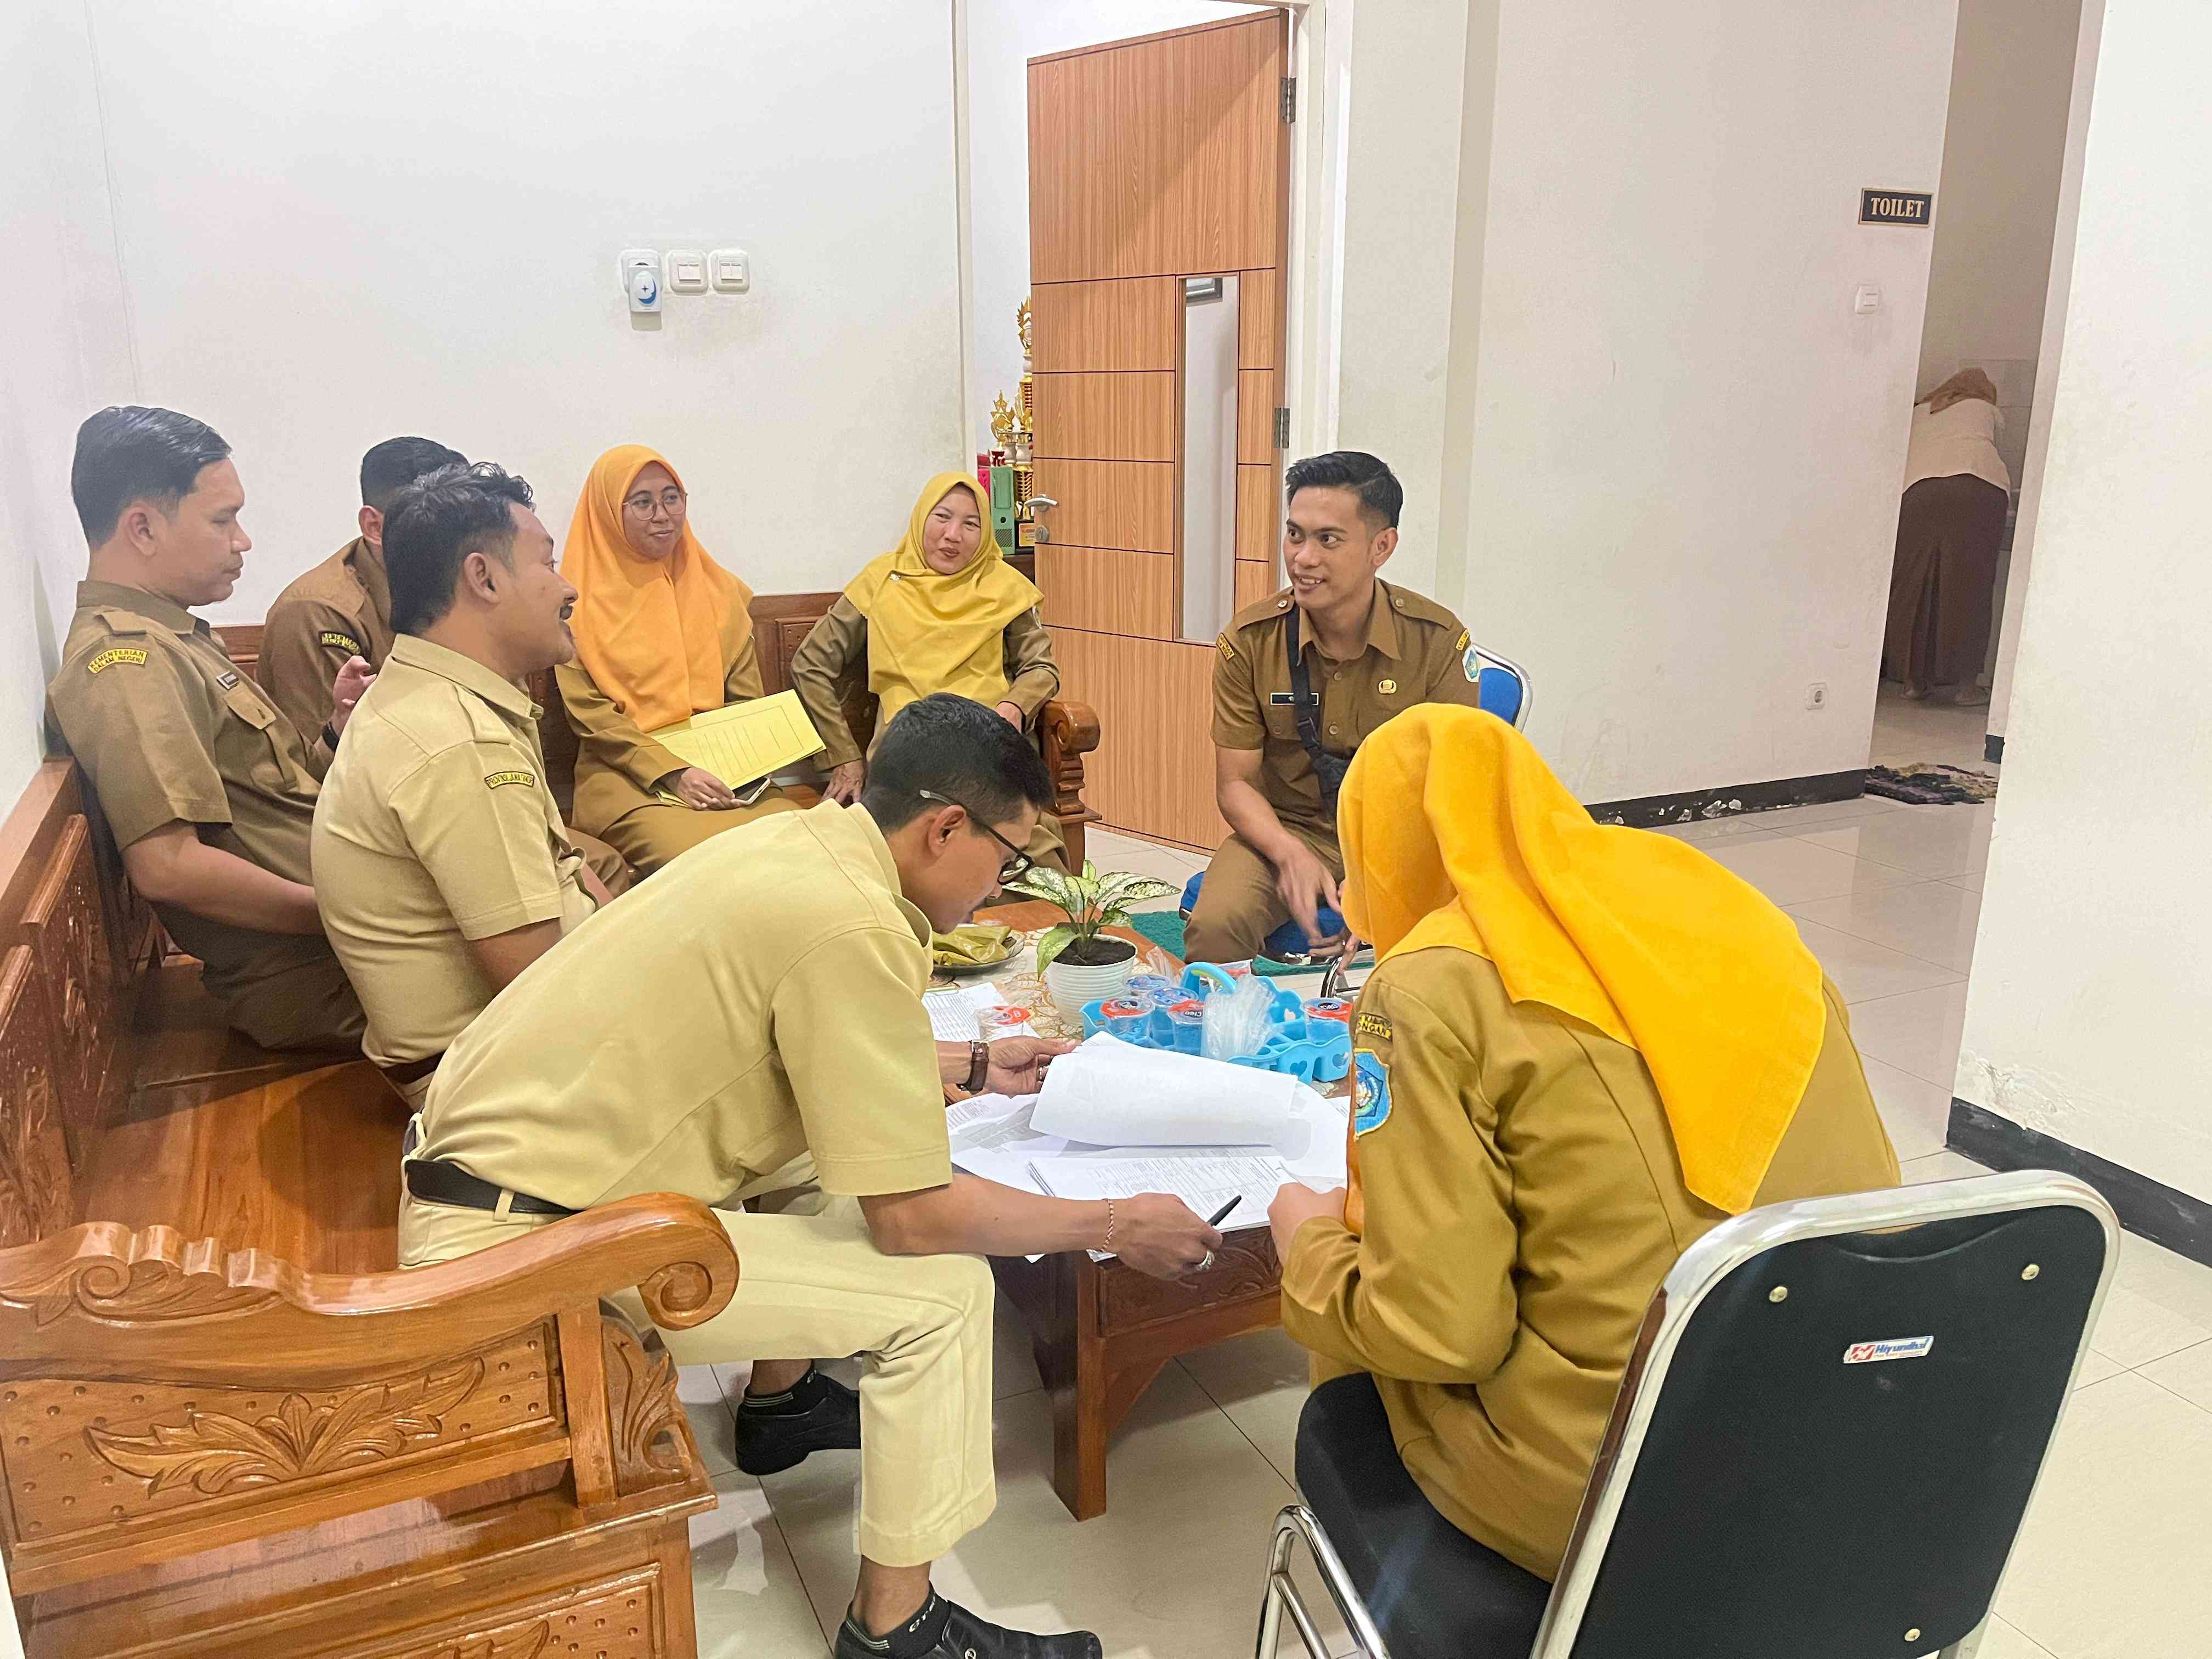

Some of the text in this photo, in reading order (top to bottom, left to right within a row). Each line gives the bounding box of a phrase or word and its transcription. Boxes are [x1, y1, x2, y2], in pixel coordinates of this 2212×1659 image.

[1871, 198, 1924, 218] TOILET
[90, 650, 144, 668] KEMENTERIAN
[94, 658, 113, 672] DALAM
